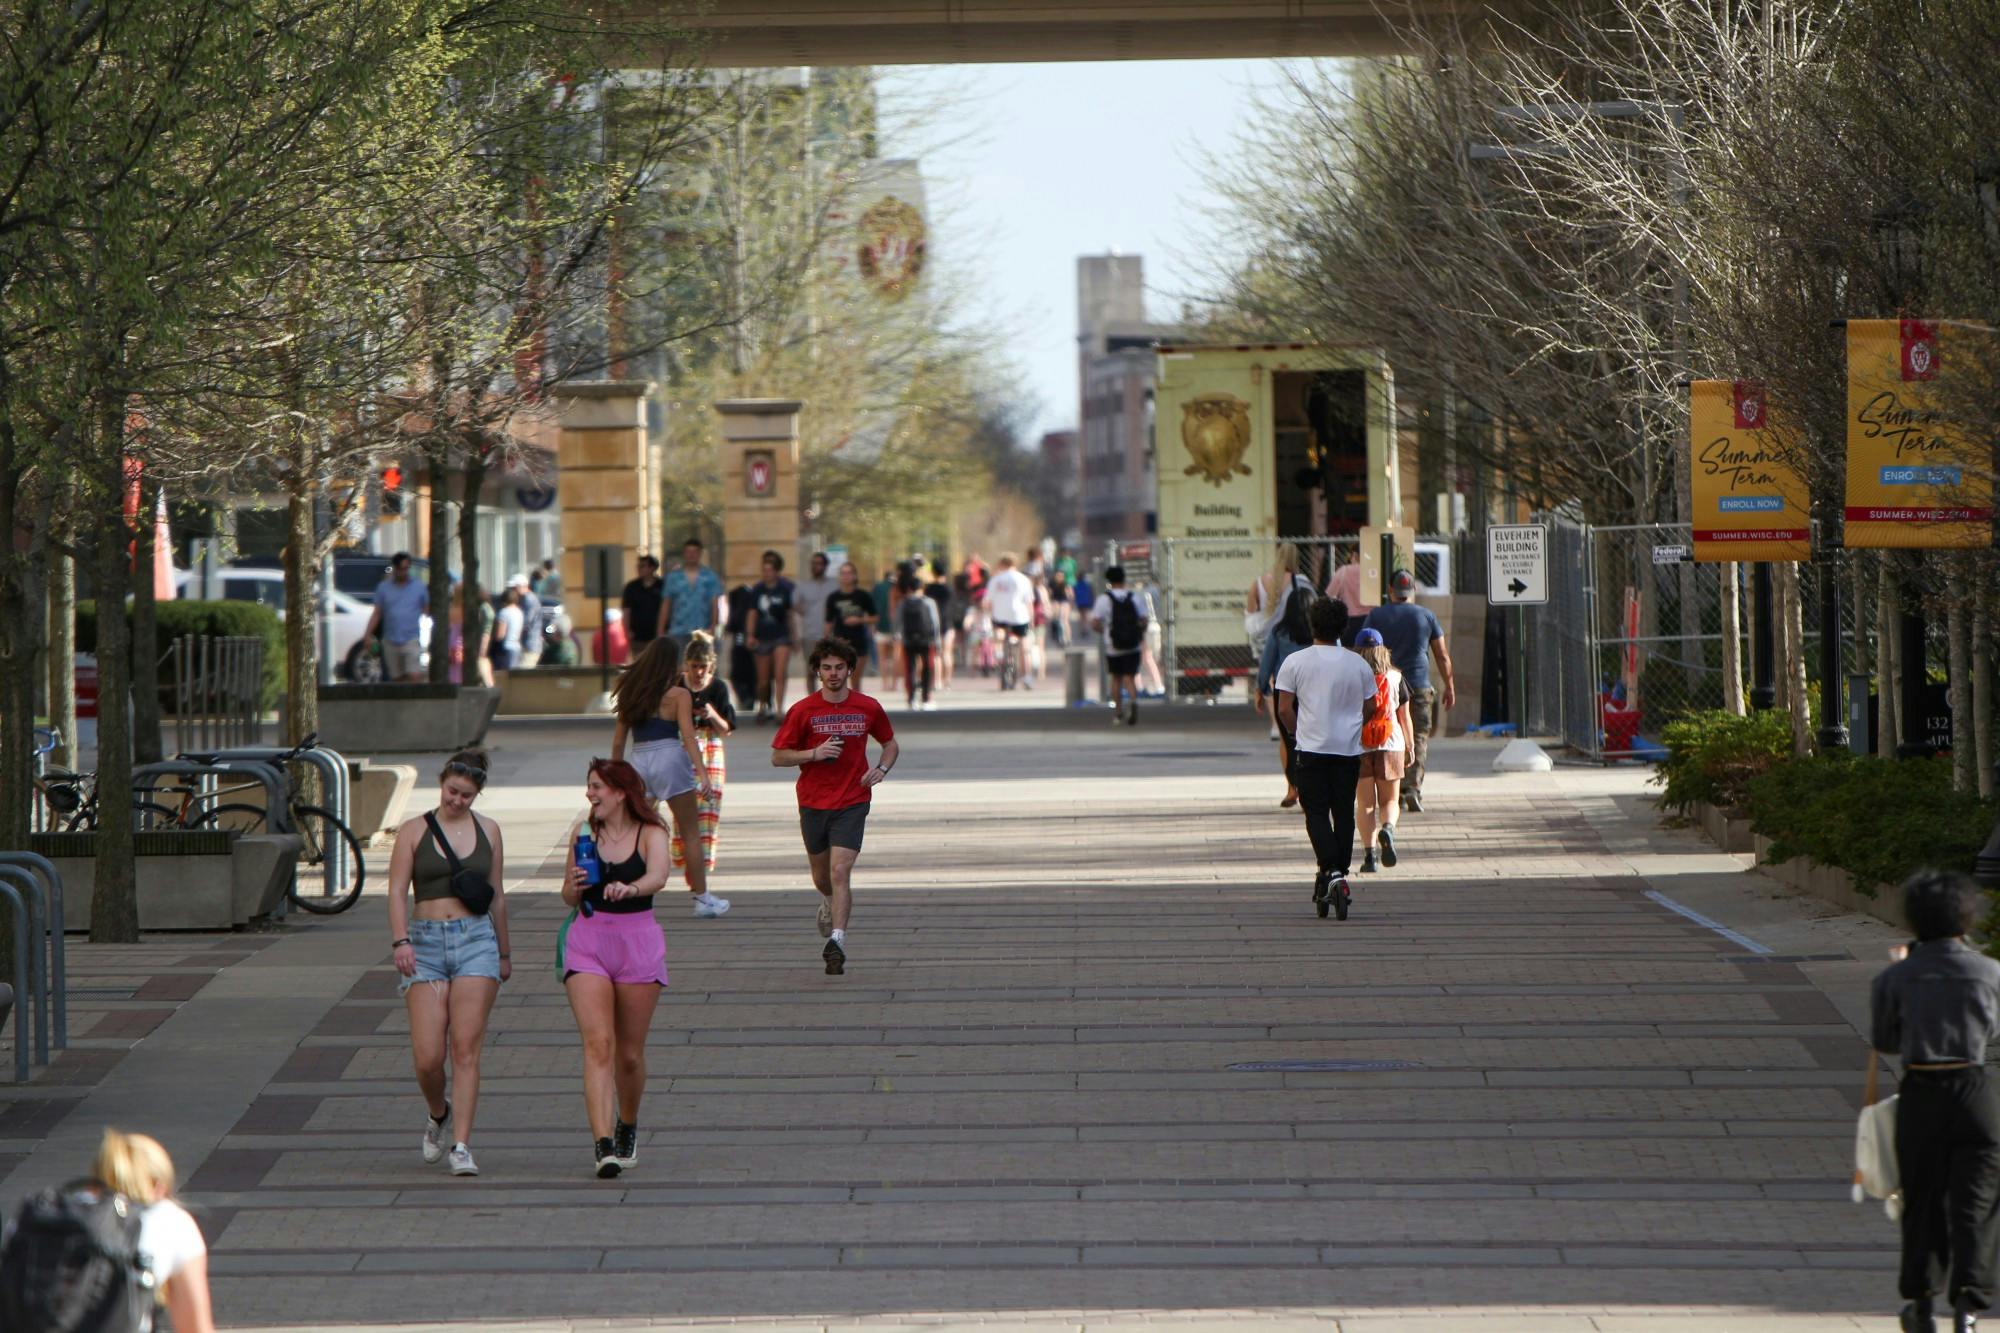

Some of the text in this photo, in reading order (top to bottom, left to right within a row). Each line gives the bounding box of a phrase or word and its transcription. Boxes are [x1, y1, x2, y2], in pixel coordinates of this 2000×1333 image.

[1720, 465, 1777, 491] Term
[1721, 499, 1780, 509] ENROLL NOW
[1193, 504, 1242, 518] Building
[1185, 526, 1251, 537] Restoration
[1495, 531, 1539, 540] ELVEHJEM
[1712, 532, 1793, 540] SUMMER.WISC.EDU
[1496, 542, 1538, 552] BUILDING
[1654, 547, 1683, 556] Federal
[1184, 547, 1253, 562] Corporation
[828, 723, 841, 731] THE
[844, 722, 866, 730] WALL
